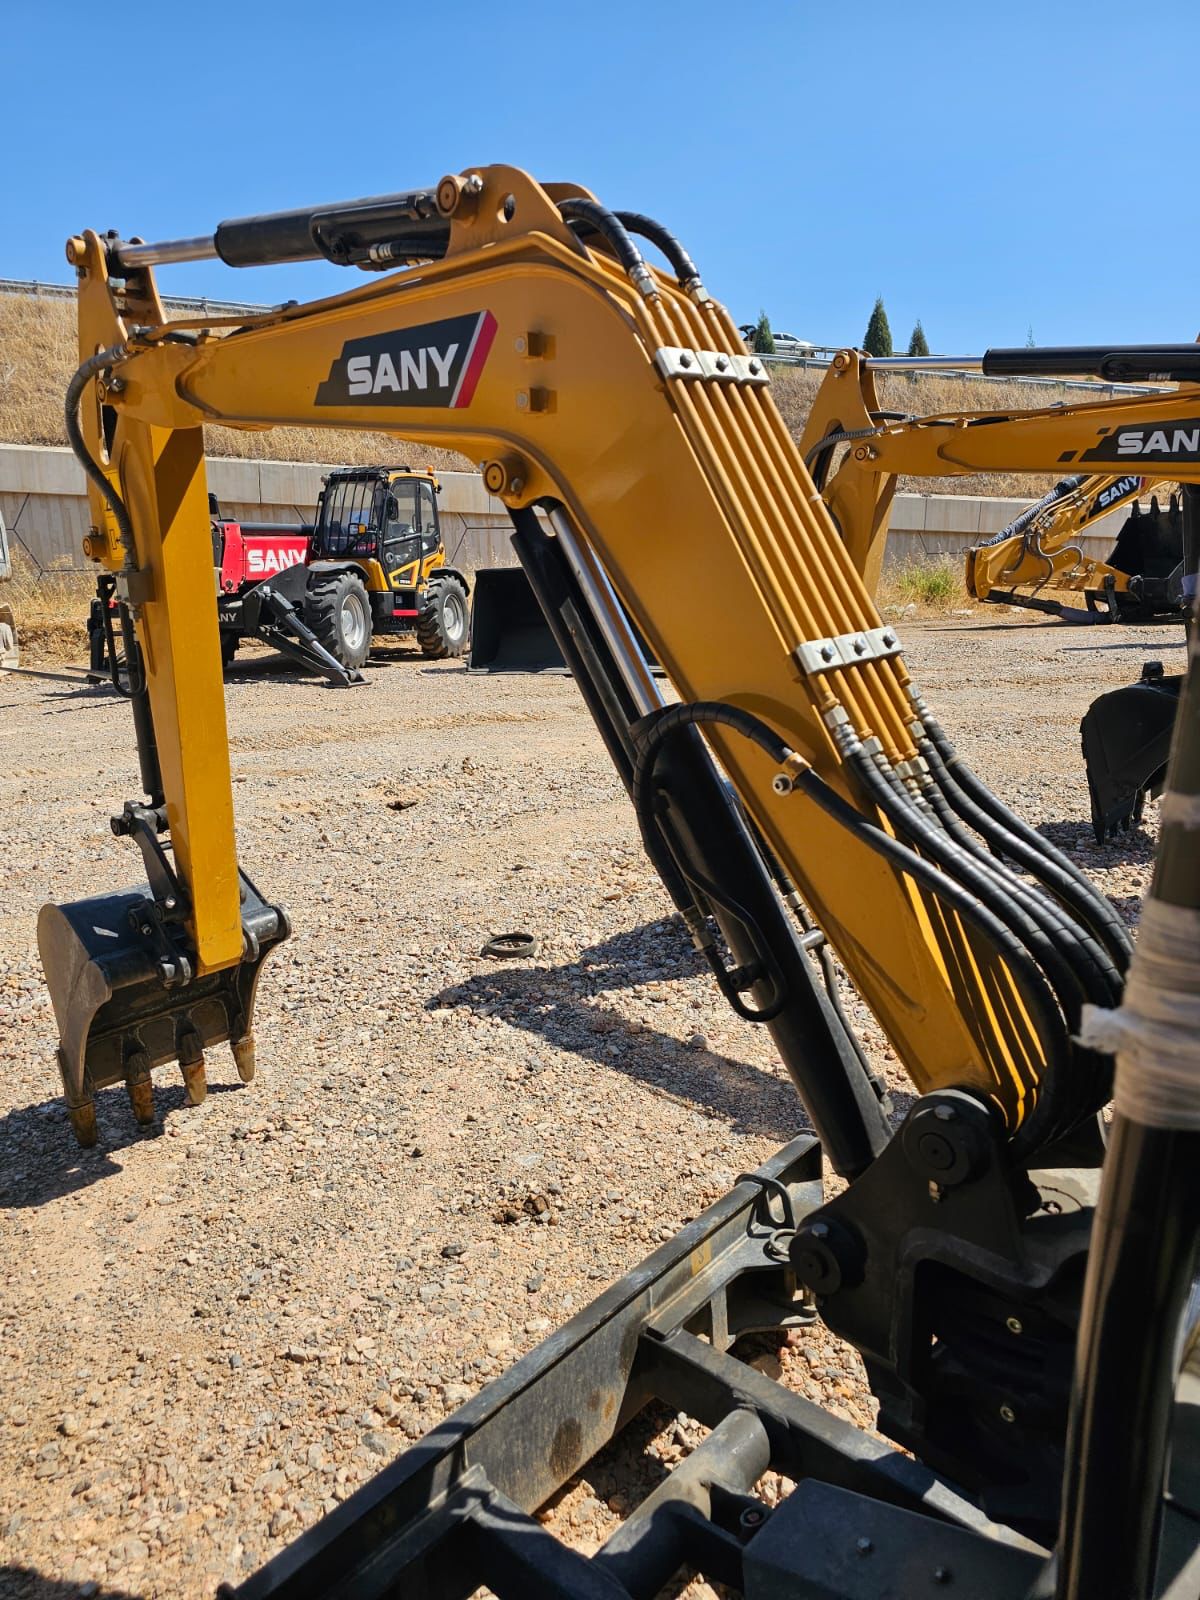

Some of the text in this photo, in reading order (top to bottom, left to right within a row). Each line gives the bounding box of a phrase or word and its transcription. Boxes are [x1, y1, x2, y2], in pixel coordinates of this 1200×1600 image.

[347, 343, 459, 396] SANY
[1117, 429, 1200, 454] SAN
[1099, 476, 1138, 507] SANY
[218, 612, 237, 622] NY
